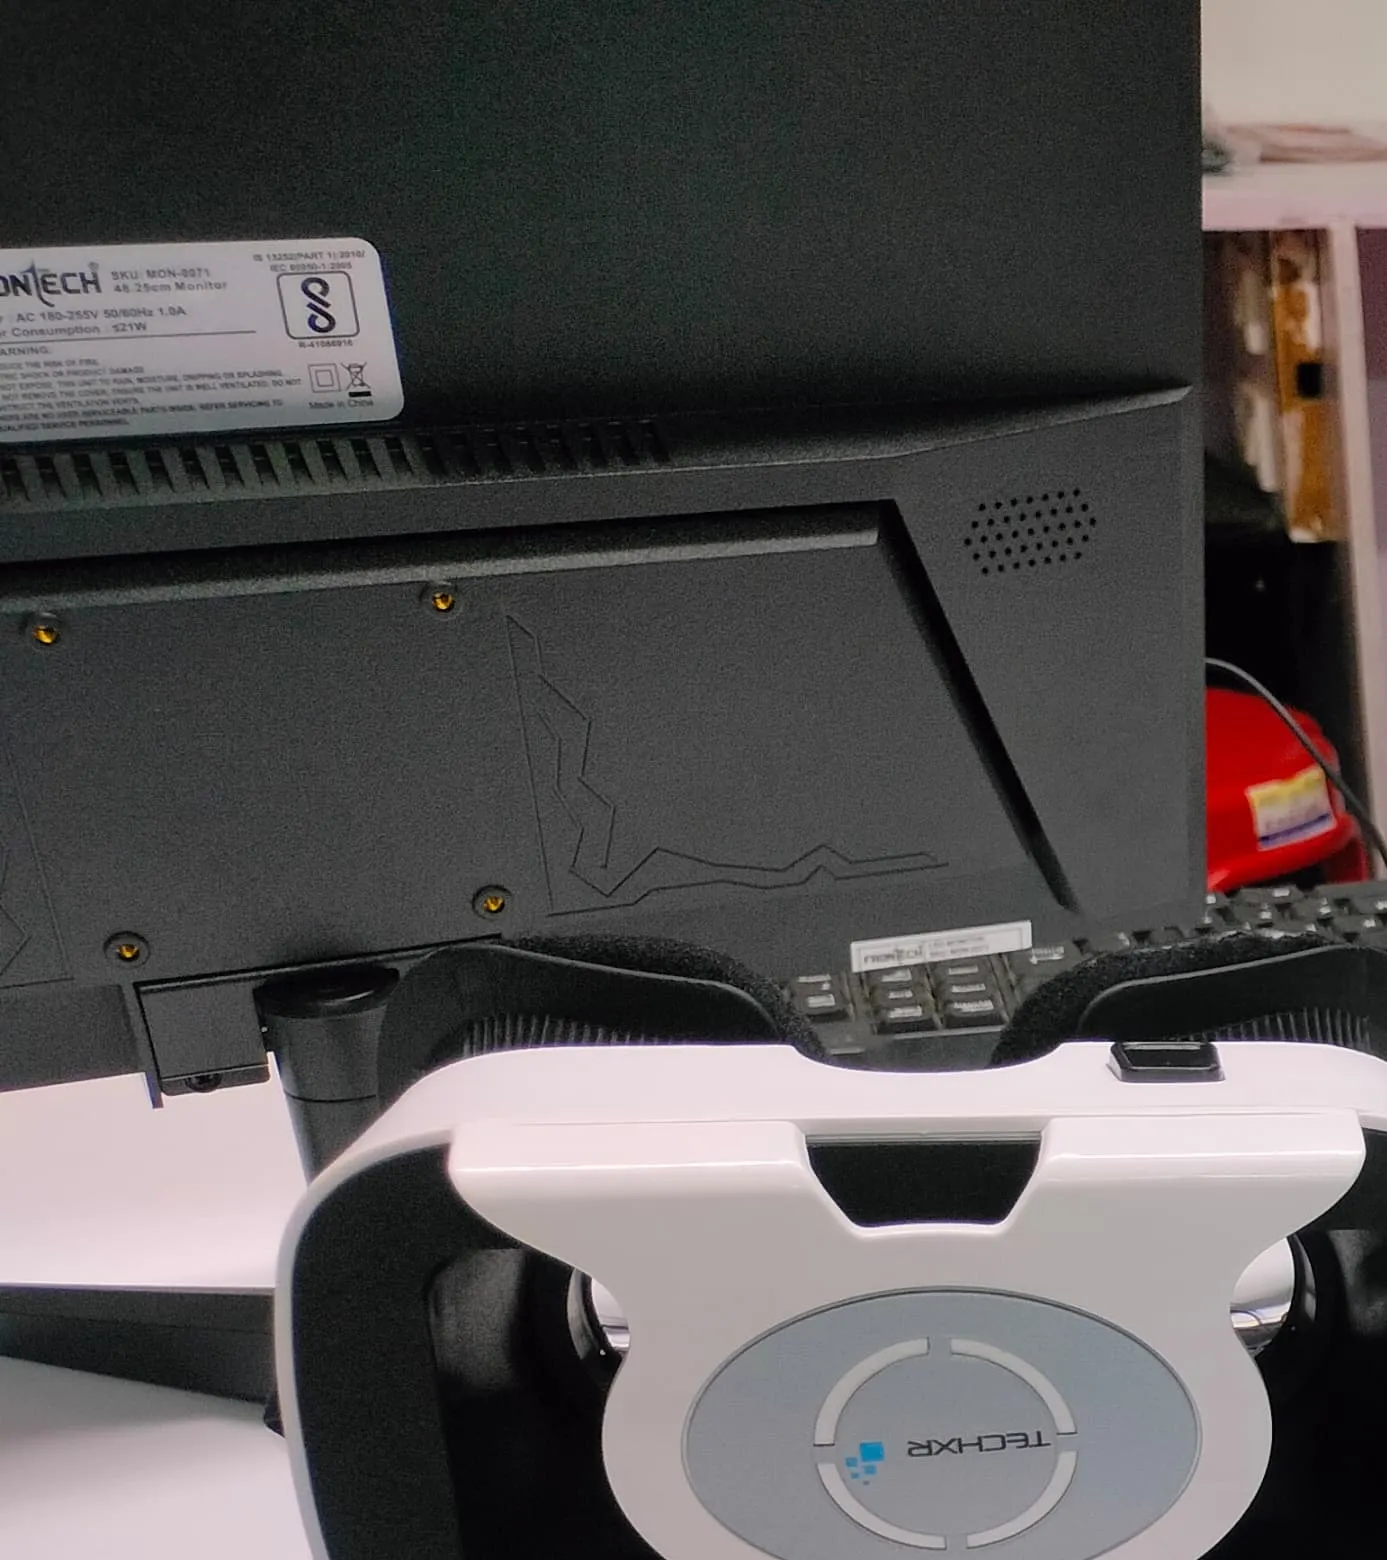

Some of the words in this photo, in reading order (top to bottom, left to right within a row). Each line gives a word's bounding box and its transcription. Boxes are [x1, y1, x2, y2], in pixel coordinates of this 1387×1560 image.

[174, 279, 228, 292] Monitor
[16, 312, 36, 323] AC
[11, 325, 101, 338] Consumption
[906, 1429, 1052, 1458] TECHXR
